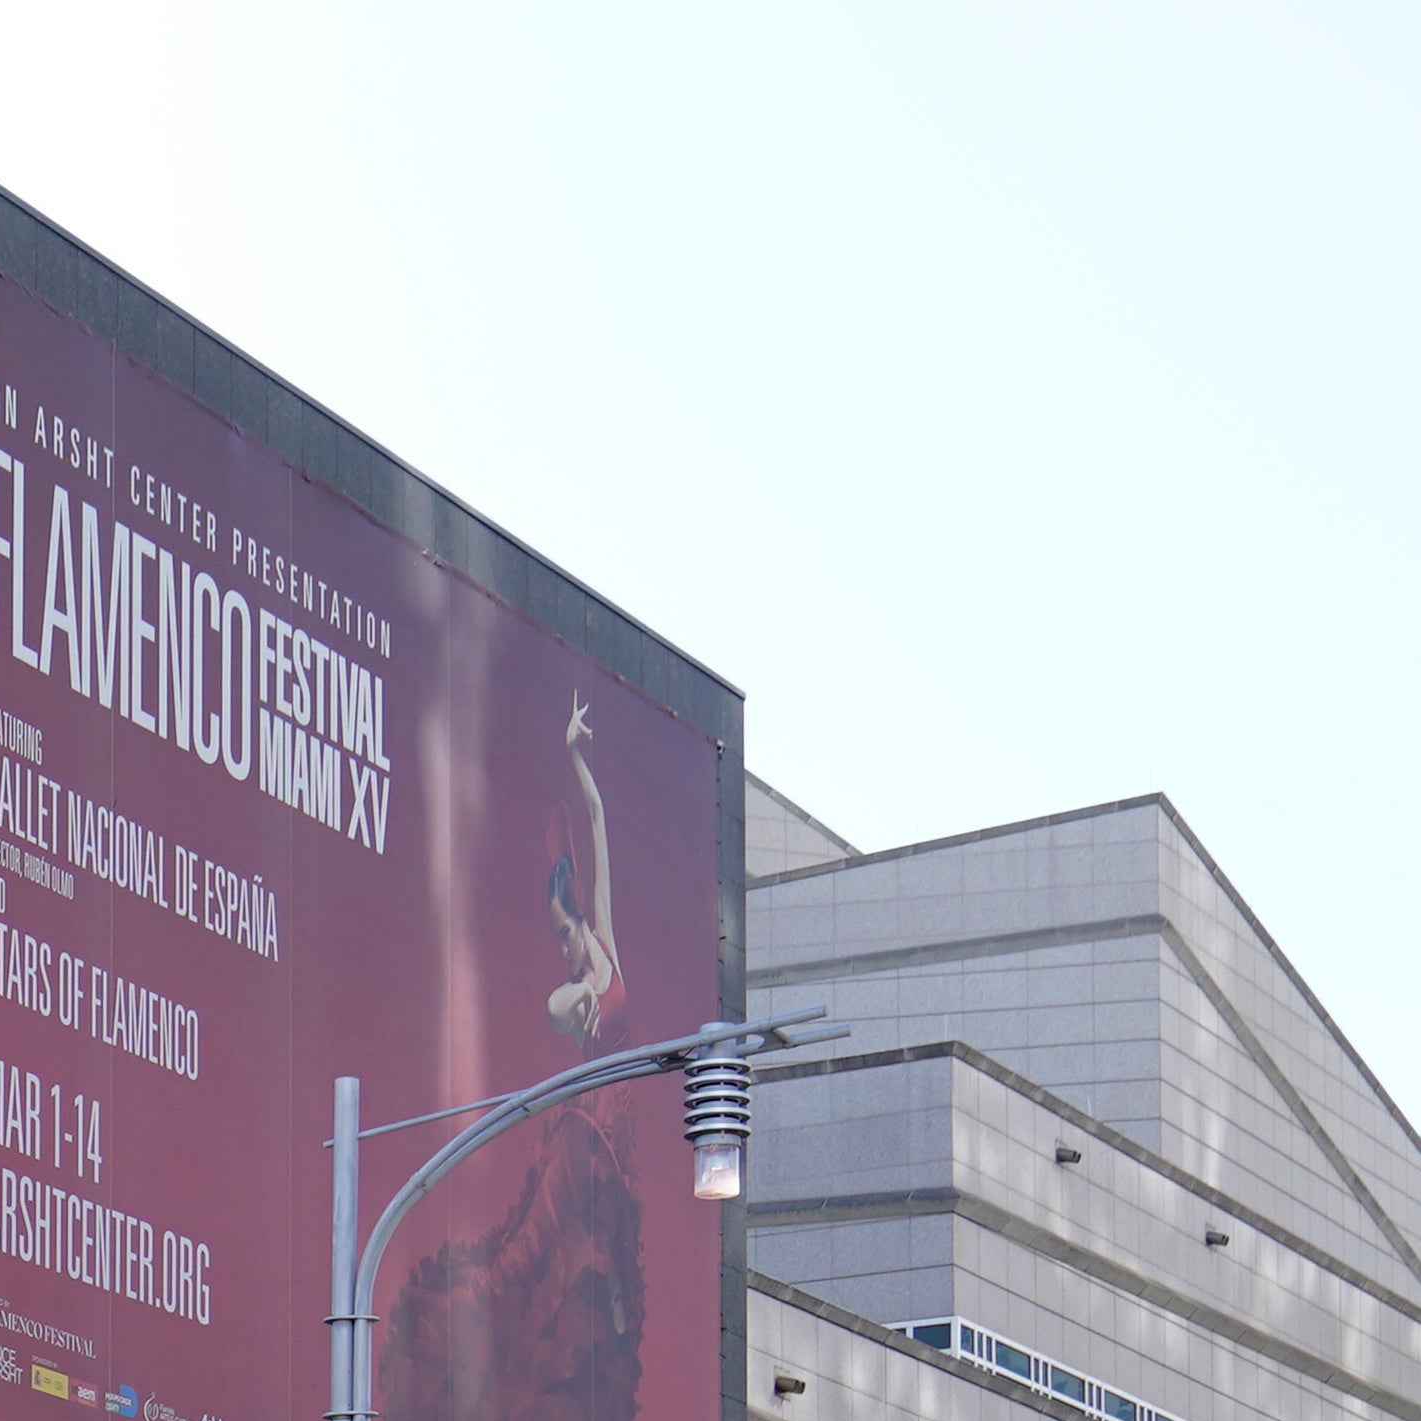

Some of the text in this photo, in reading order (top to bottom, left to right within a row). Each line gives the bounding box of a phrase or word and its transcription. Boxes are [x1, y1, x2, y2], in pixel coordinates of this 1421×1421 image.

[34, 406, 115, 489] ARSHT
[130, 464, 216, 553] CENTER
[233, 527, 391, 659] PRESENTATION
[259, 607, 391, 772] FESTIVAL
[259, 708, 391, 856] MIAMI XV
[24, 851, 51, 891] RUBÉN
[51, 865, 75, 900] OLMO
[67, 789, 168, 909] NACIONAL
[175, 844, 199, 924] DE
[204, 858, 279, 963] ESPAÑA
[58, 950, 85, 1031] OF
[91, 965, 200, 1081] FLAMENCO
[51, 1083, 103, 1184] 1-14
[44, 1324, 97, 1359] FESTIVAL
